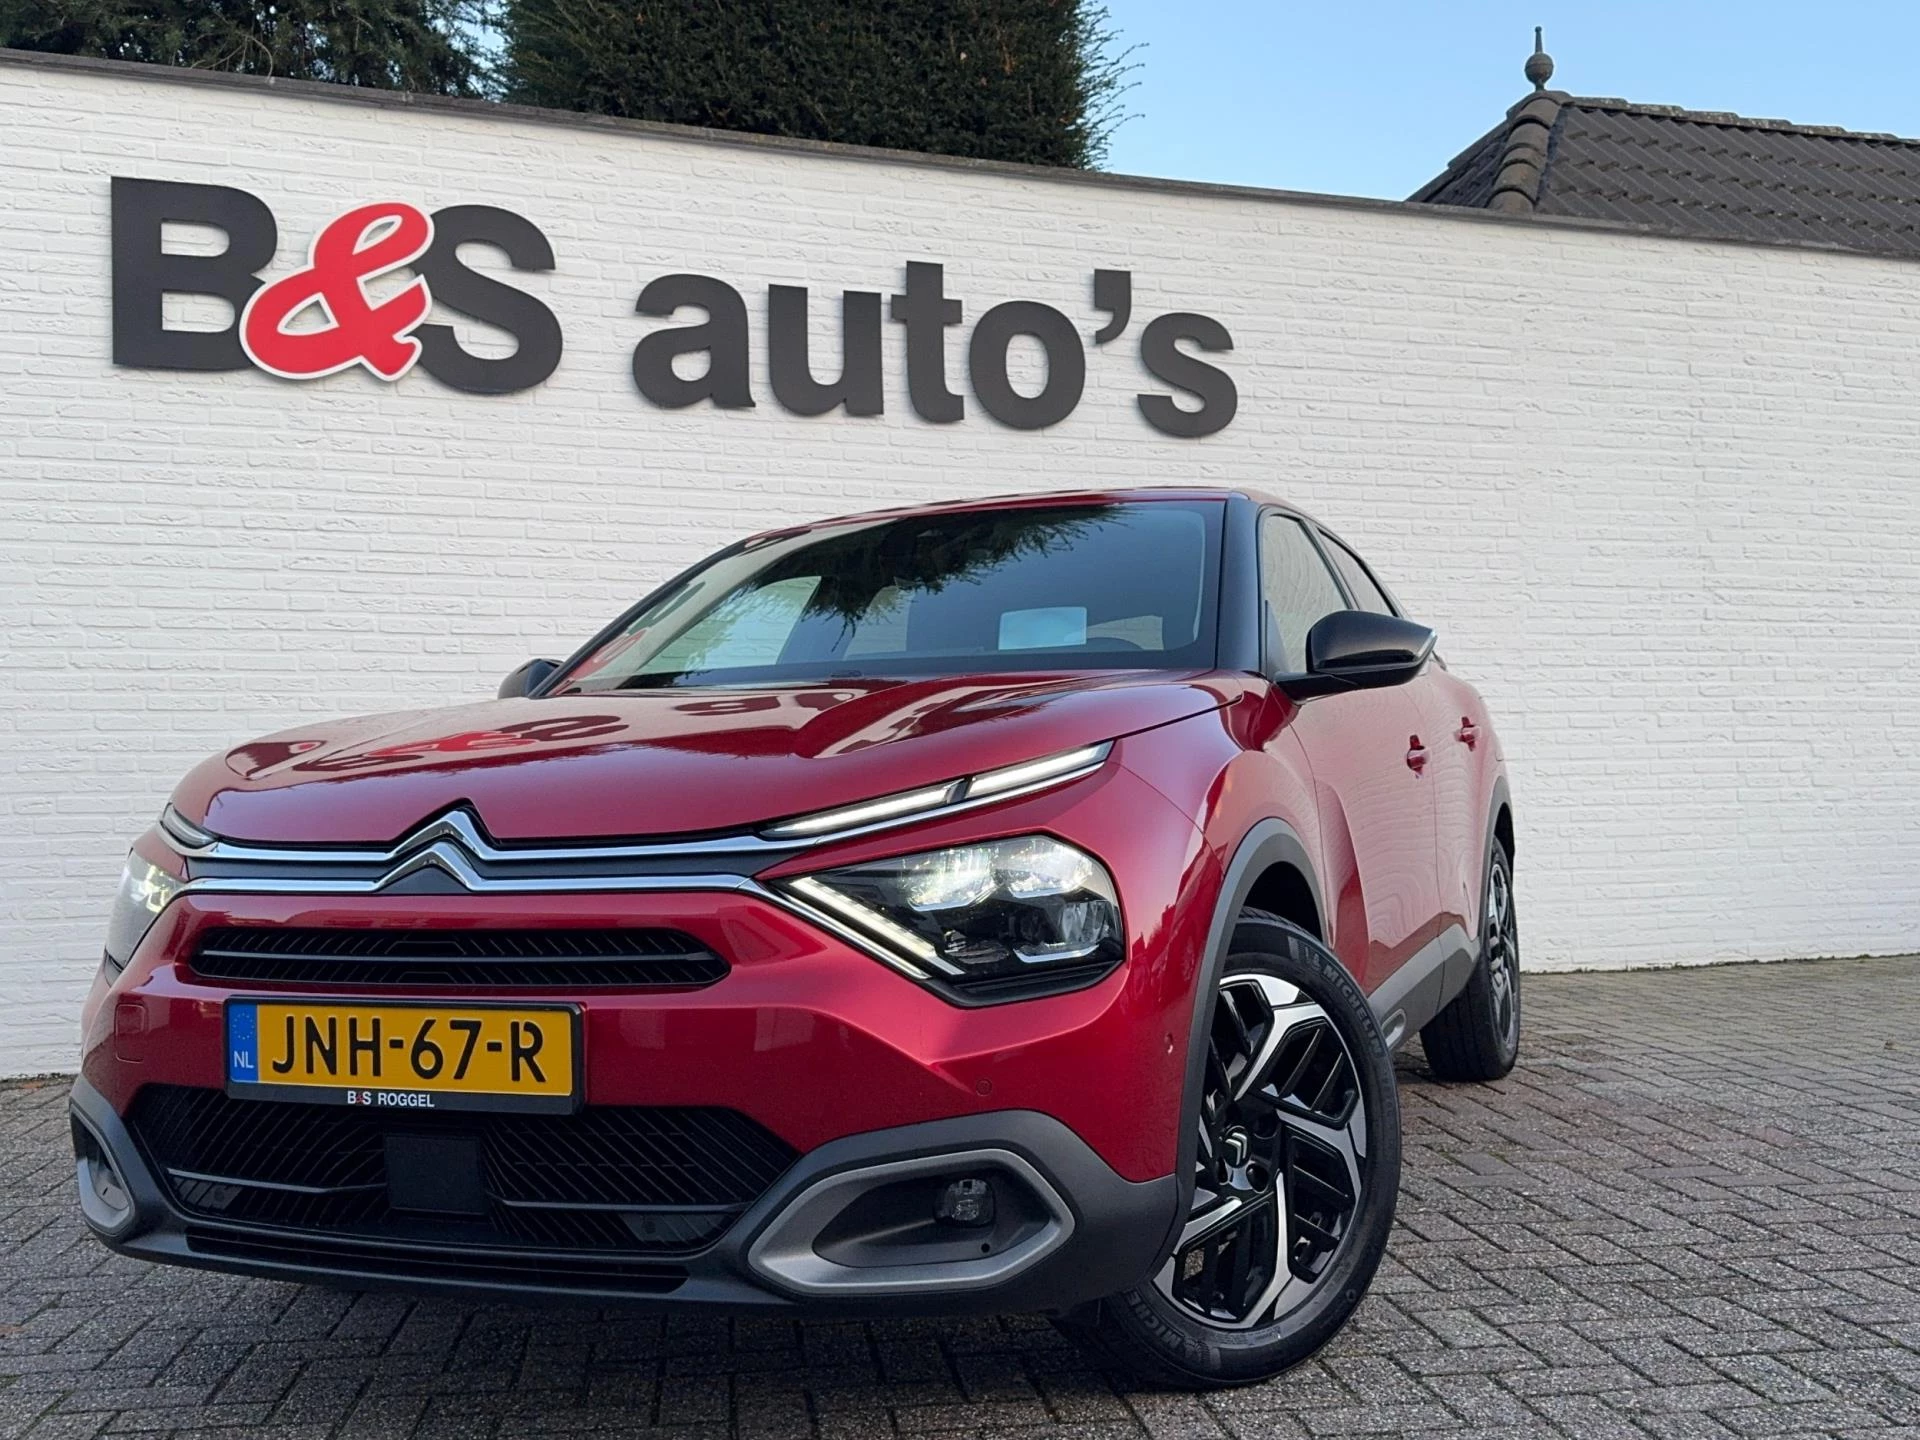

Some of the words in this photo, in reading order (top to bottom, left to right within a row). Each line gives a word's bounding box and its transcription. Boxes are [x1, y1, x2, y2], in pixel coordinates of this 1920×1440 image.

[110, 176, 563, 394] B&S
[632, 261, 1238, 437] auto's
[1323, 965, 1381, 1054] MICHELIN
[234, 1050, 254, 1069] NL
[272, 1015, 546, 1083] JNH-67-R
[378, 1092, 435, 1108] ROGGEL
[1124, 1289, 1184, 1349] MICHE
